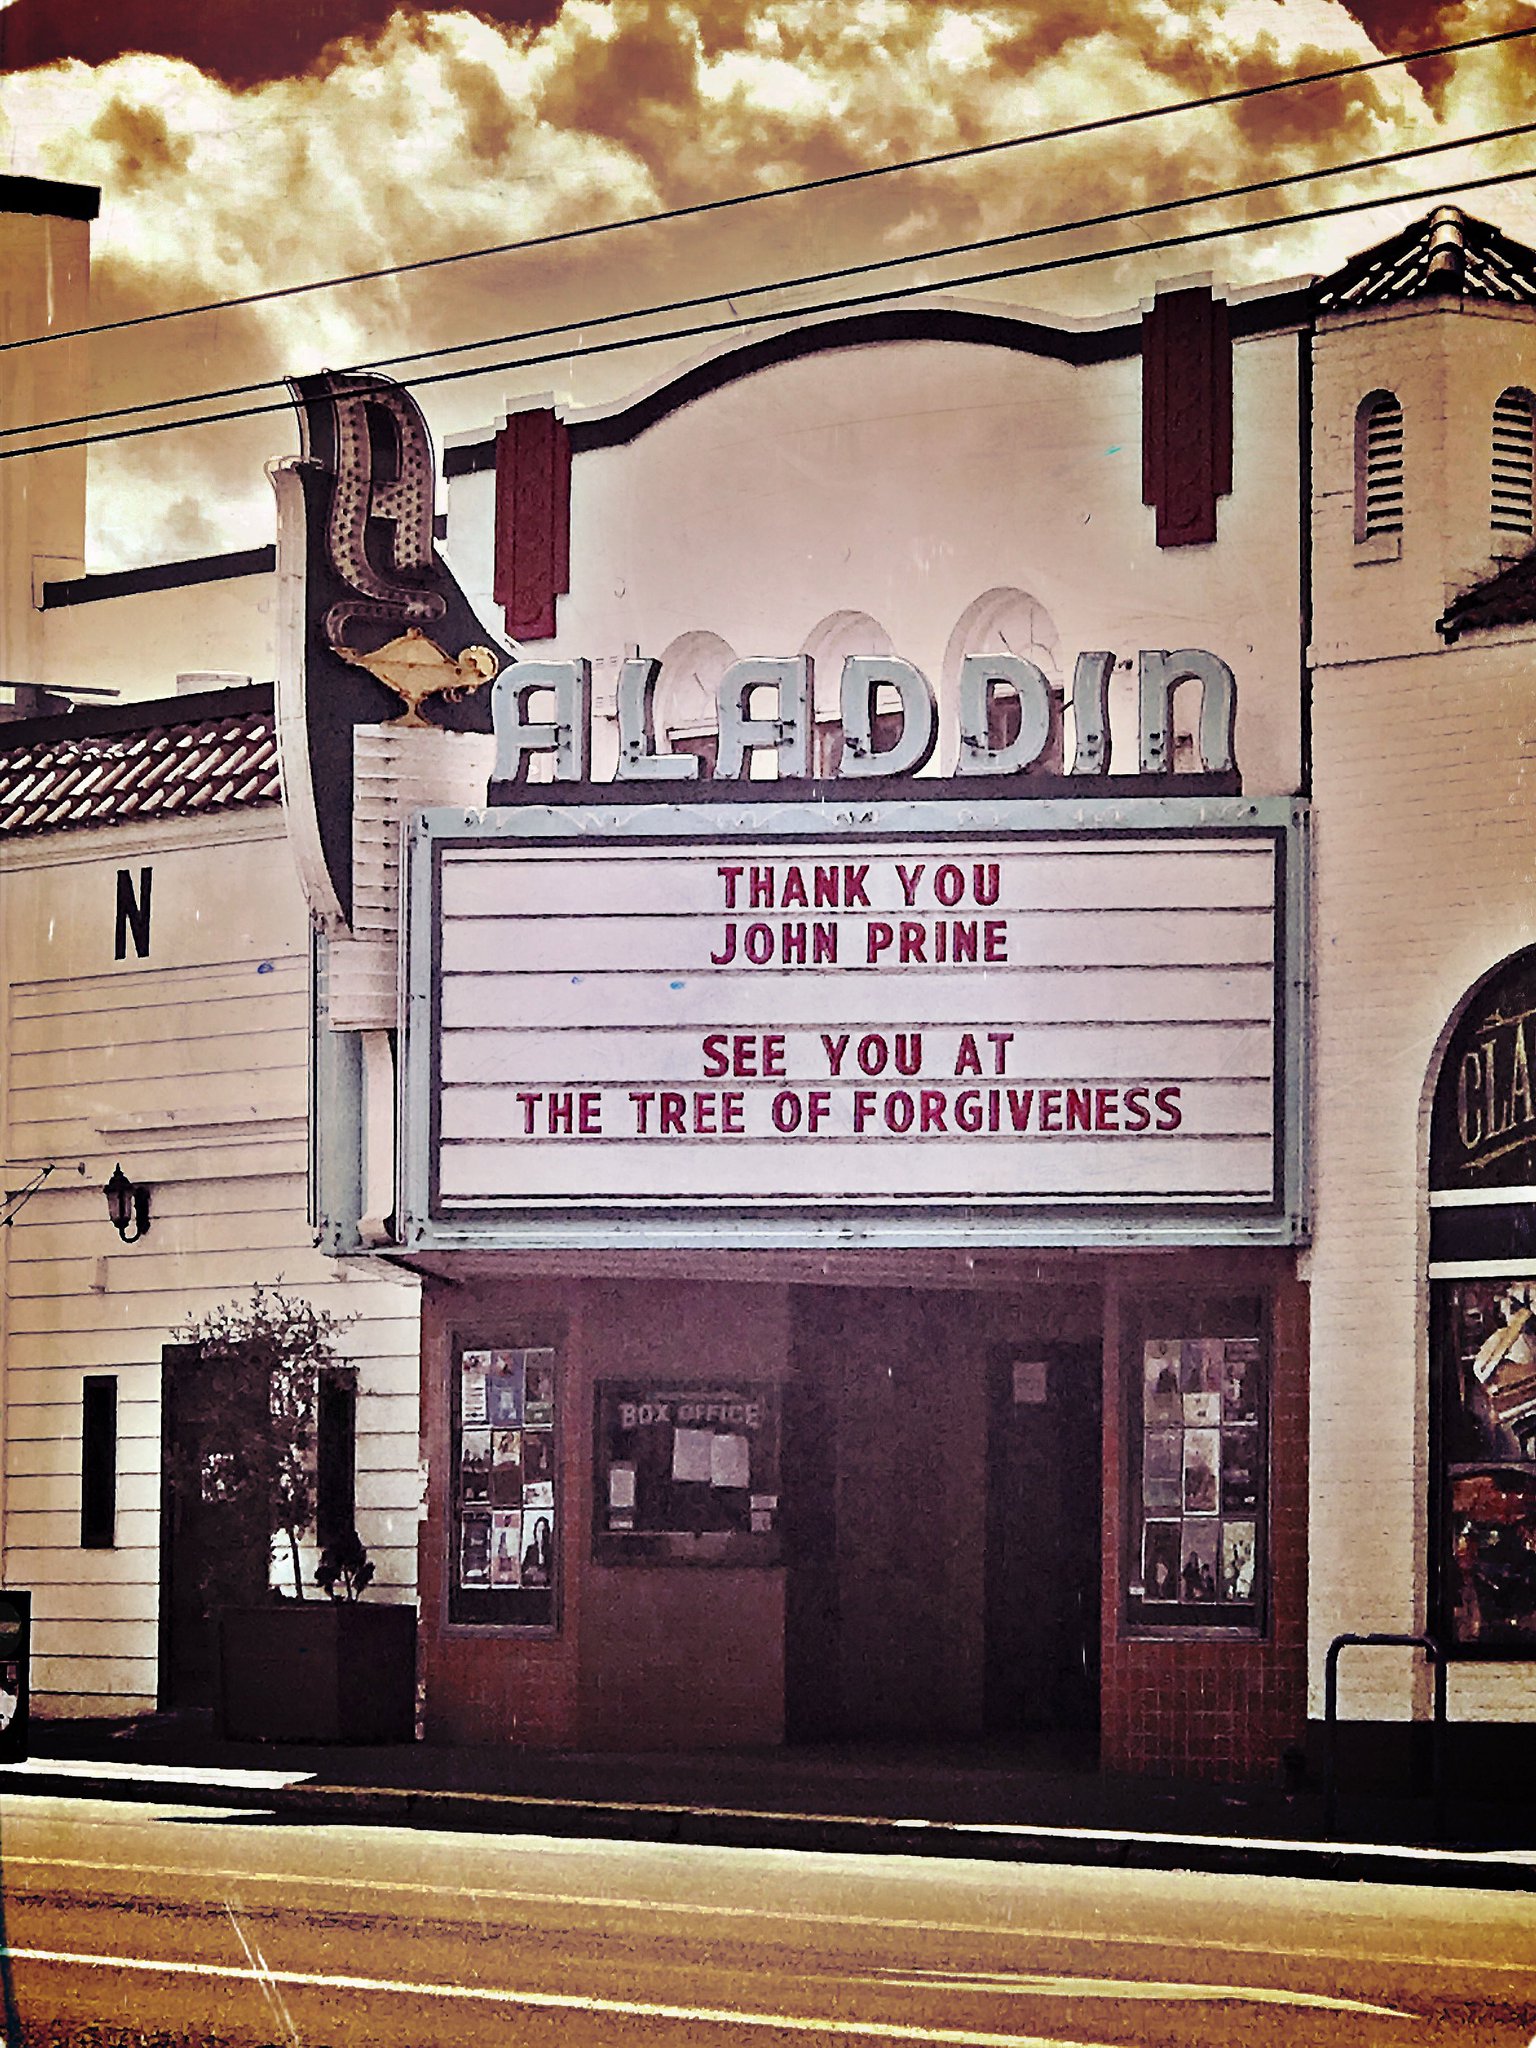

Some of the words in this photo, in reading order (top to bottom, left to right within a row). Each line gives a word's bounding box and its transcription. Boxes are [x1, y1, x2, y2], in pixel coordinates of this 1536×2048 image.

[490, 648, 1239, 782] ALADDIN
[718, 864, 871, 908] THANK
[896, 863, 1000, 906] YOU
[115, 866, 152, 960] N
[711, 922, 838, 965] JOHN
[867, 920, 1008, 963] PRINE
[702, 1034, 786, 1077] SEE
[821, 1033, 922, 1076] YOU
[955, 1032, 1014, 1075] AT
[1457, 1020, 1536, 1150] CLA
[516, 1092, 602, 1134] THE
[629, 1092, 745, 1133] TREE
[772, 1091, 832, 1133] OF
[854, 1087, 1182, 1132] FORGIVENESS
[619, 1403, 671, 1428] BOX
[677, 1403, 762, 1428] OFFICE
